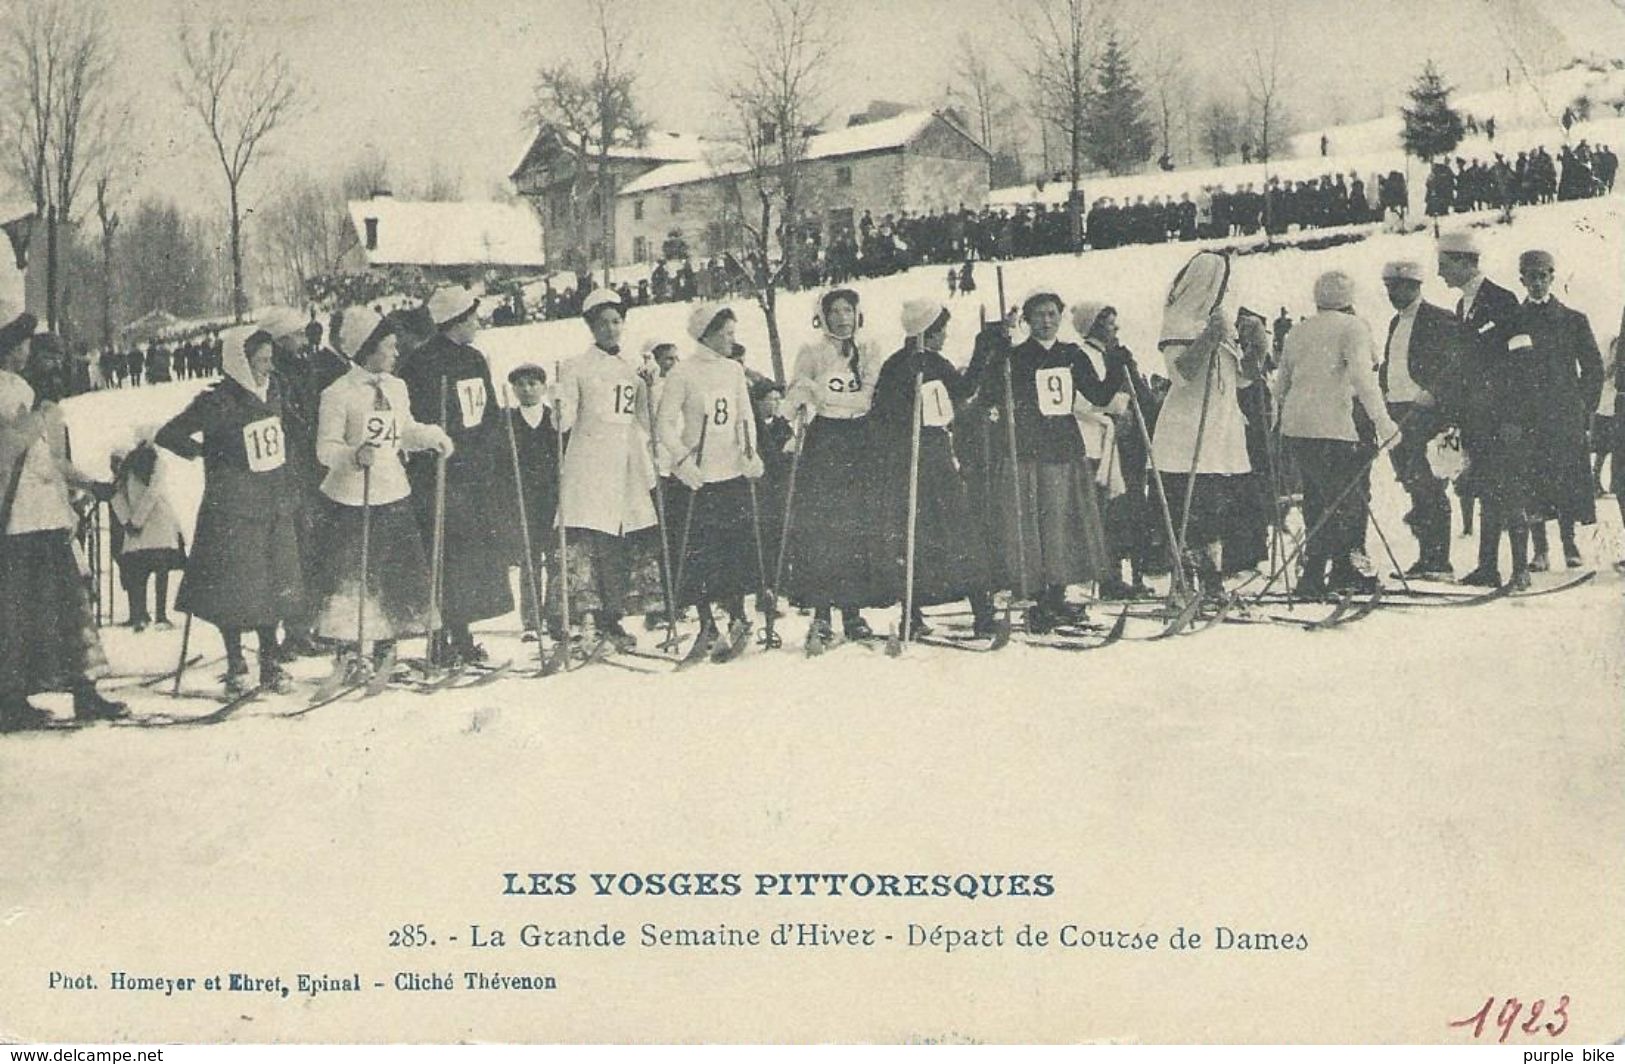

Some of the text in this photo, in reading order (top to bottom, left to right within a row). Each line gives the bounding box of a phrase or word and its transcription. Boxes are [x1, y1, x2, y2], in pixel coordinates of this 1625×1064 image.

[464, 385, 487, 417] 14
[1046, 375, 1063, 405] 9
[713, 396, 729, 426] 8
[248, 424, 279, 460] 18
[1449, 994, 1570, 1043] 1923
